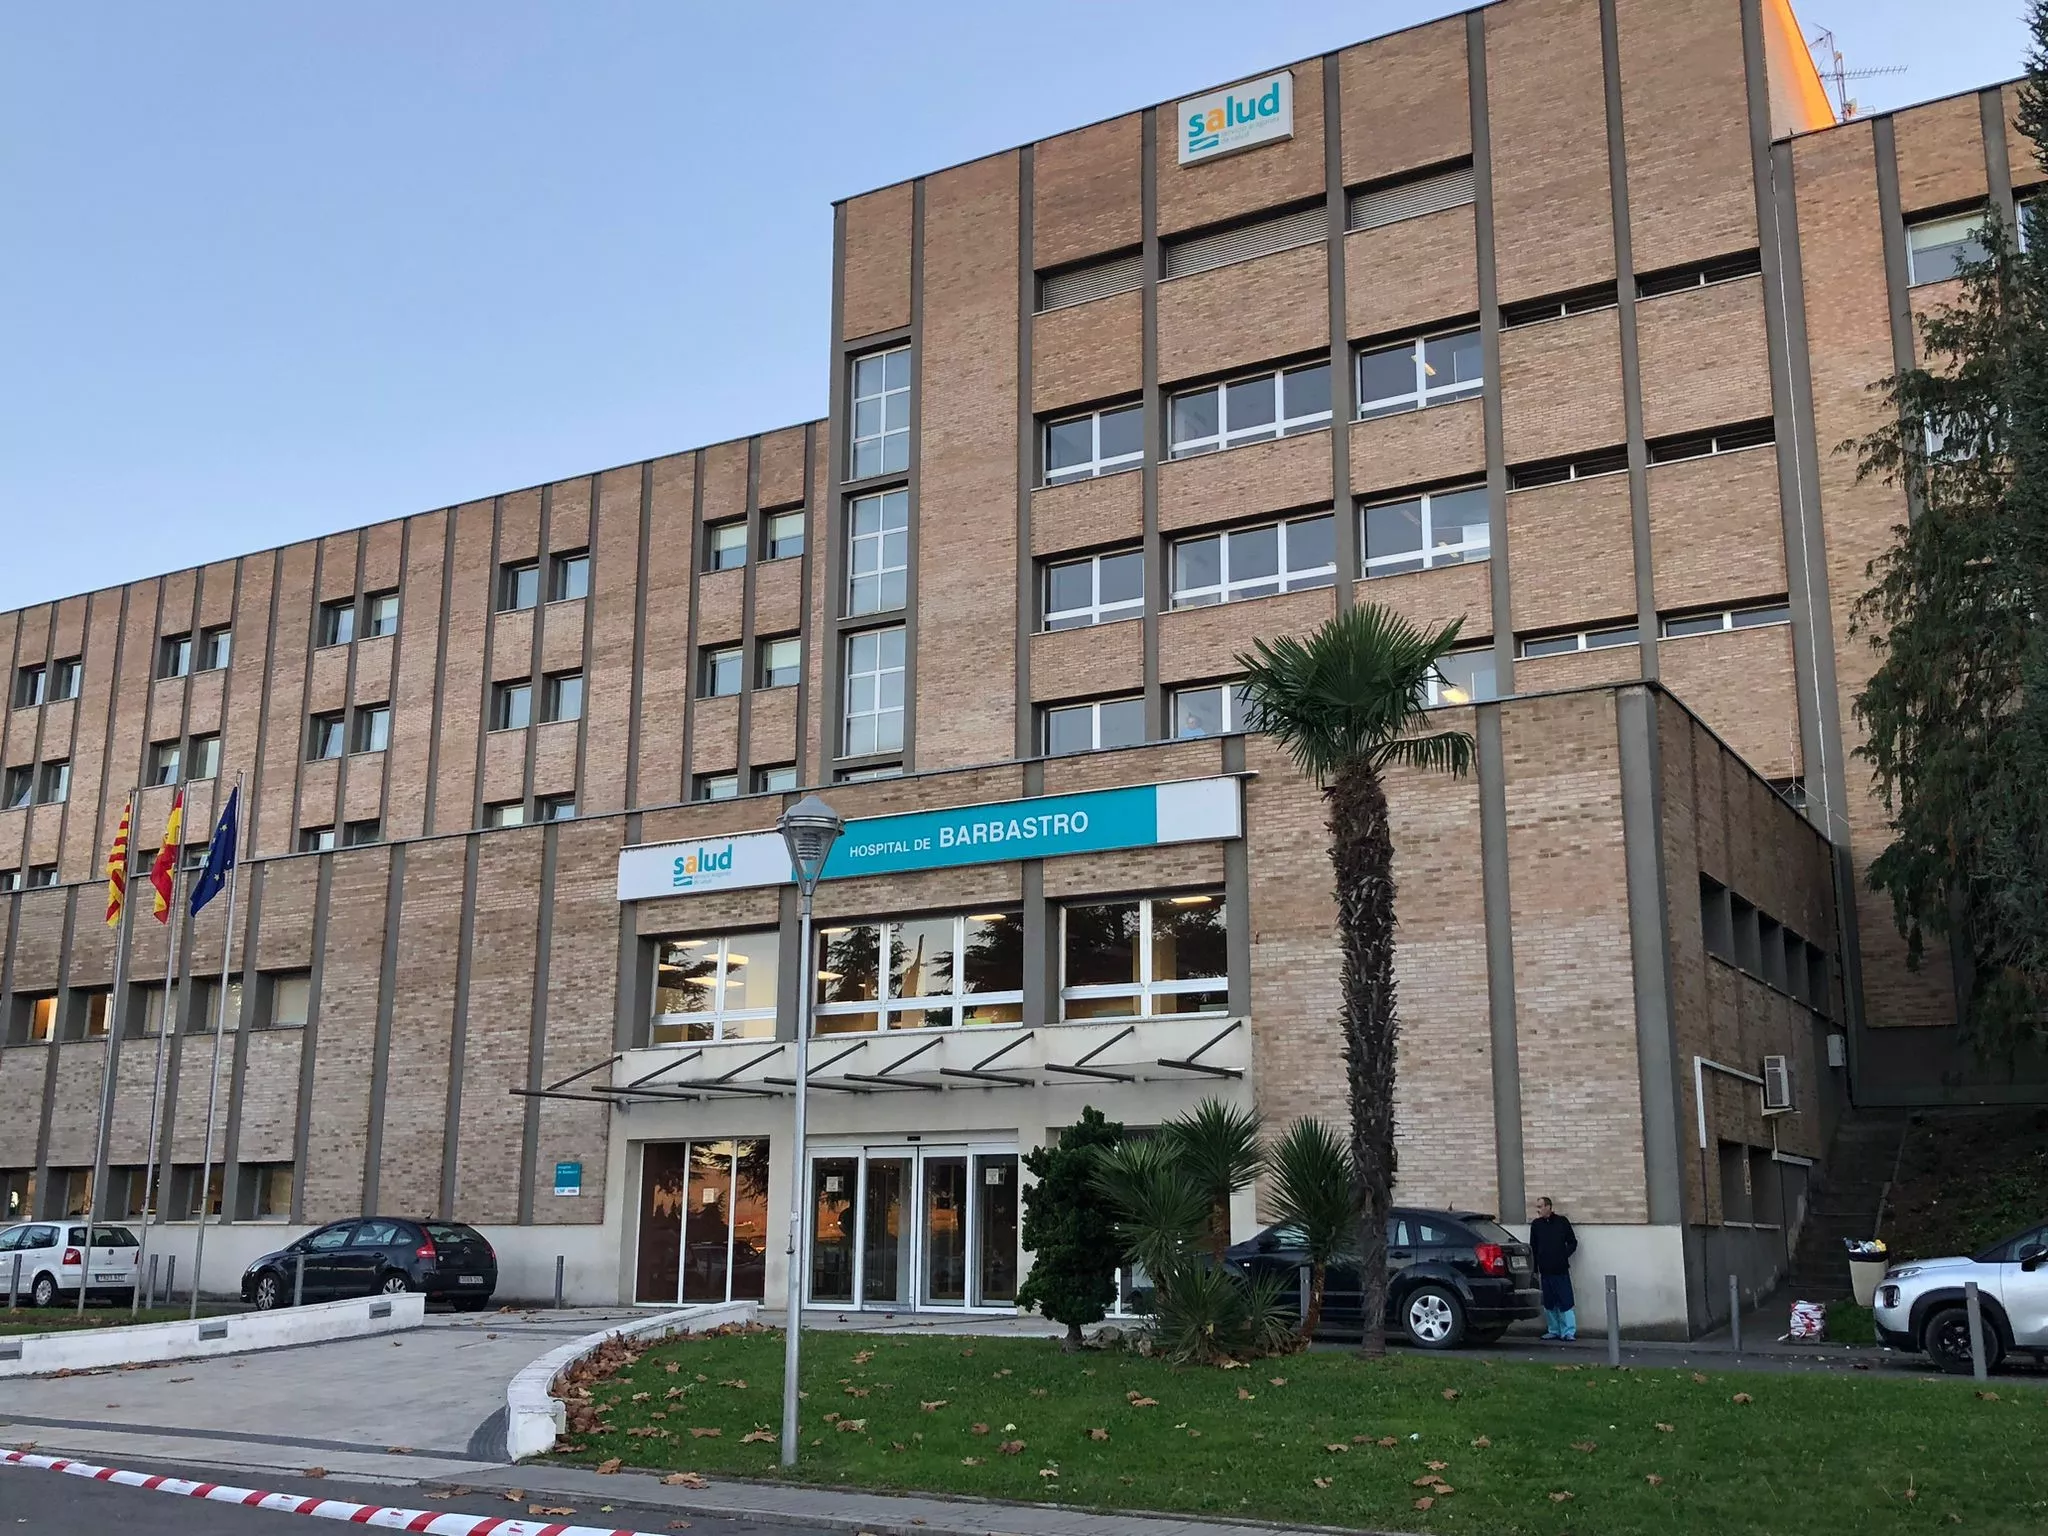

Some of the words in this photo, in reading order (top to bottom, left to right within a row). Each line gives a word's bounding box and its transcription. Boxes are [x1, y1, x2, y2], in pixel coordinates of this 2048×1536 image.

[1188, 81, 1280, 138] salud
[849, 839, 910, 858] HOSPITAL
[914, 837, 931, 851] DE
[939, 811, 1089, 849] BARBASTRO
[673, 843, 733, 875] salud
